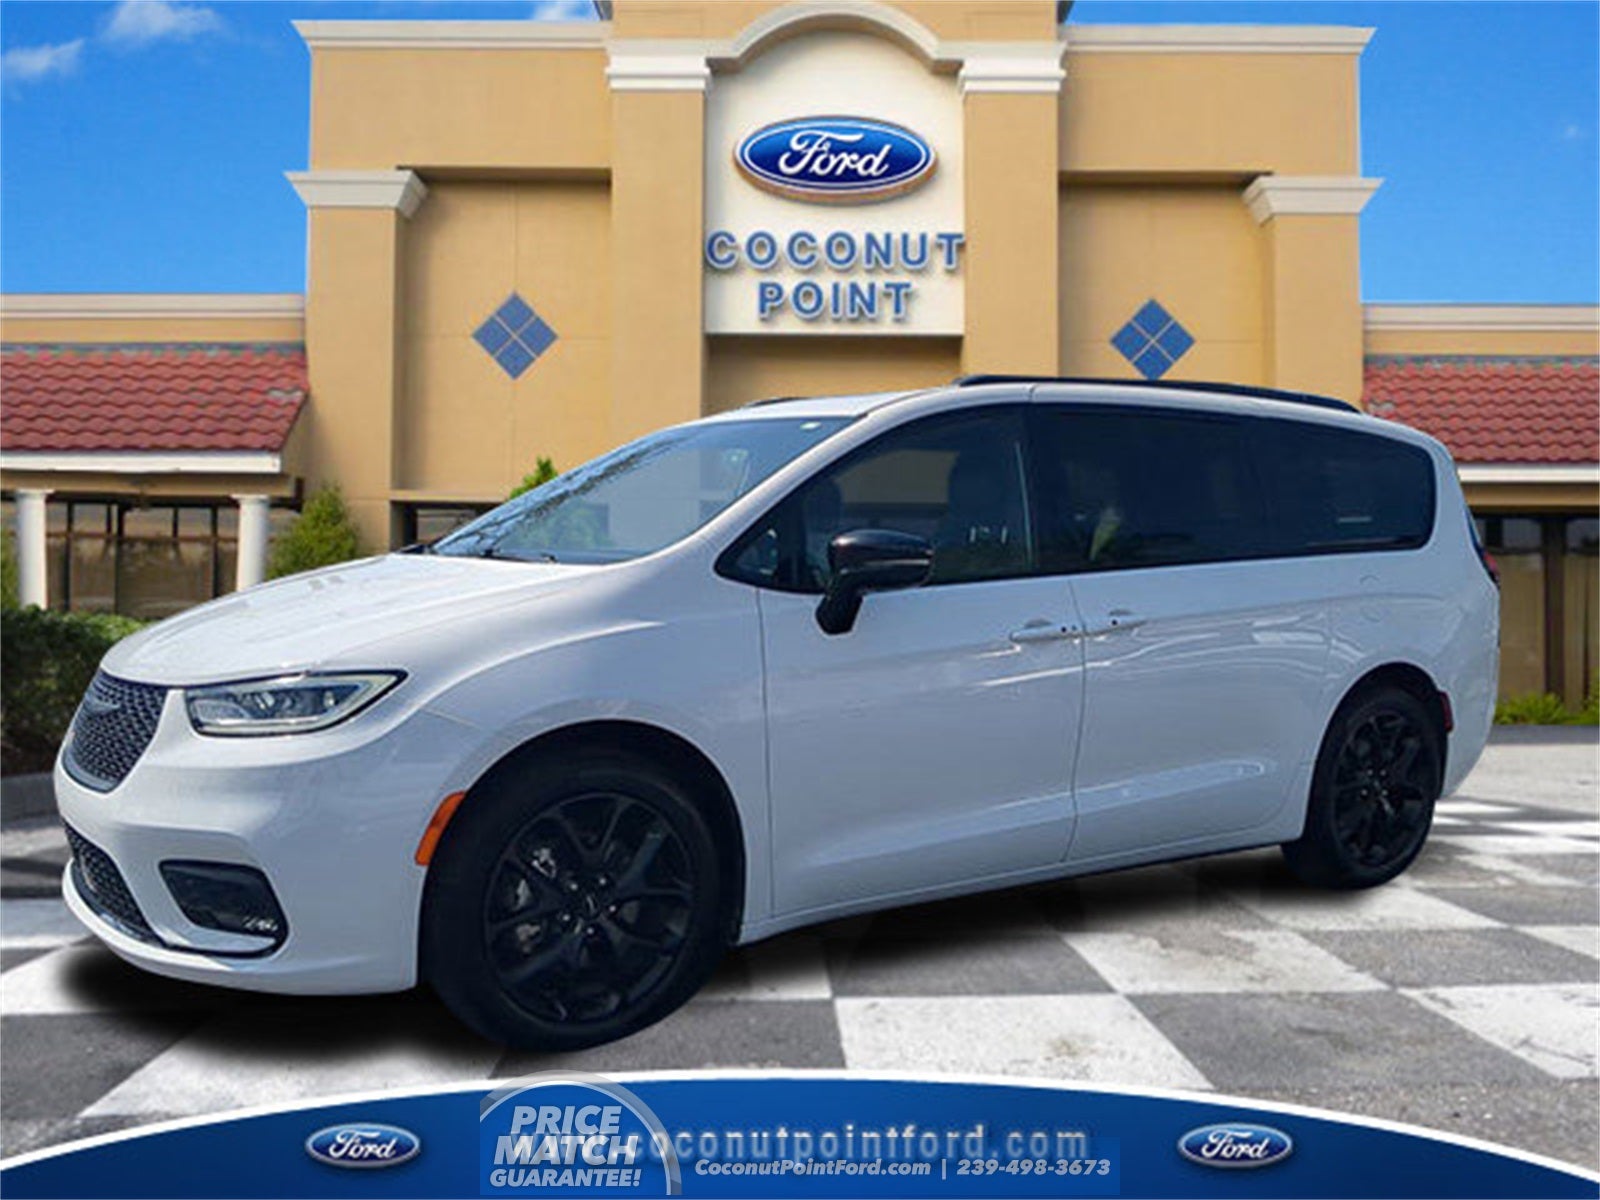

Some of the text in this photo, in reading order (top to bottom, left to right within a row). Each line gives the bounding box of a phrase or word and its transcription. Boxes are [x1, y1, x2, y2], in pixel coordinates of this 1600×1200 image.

[778, 129, 892, 177] Ford
[705, 231, 965, 269] COCONUT
[757, 281, 912, 318] POINT
